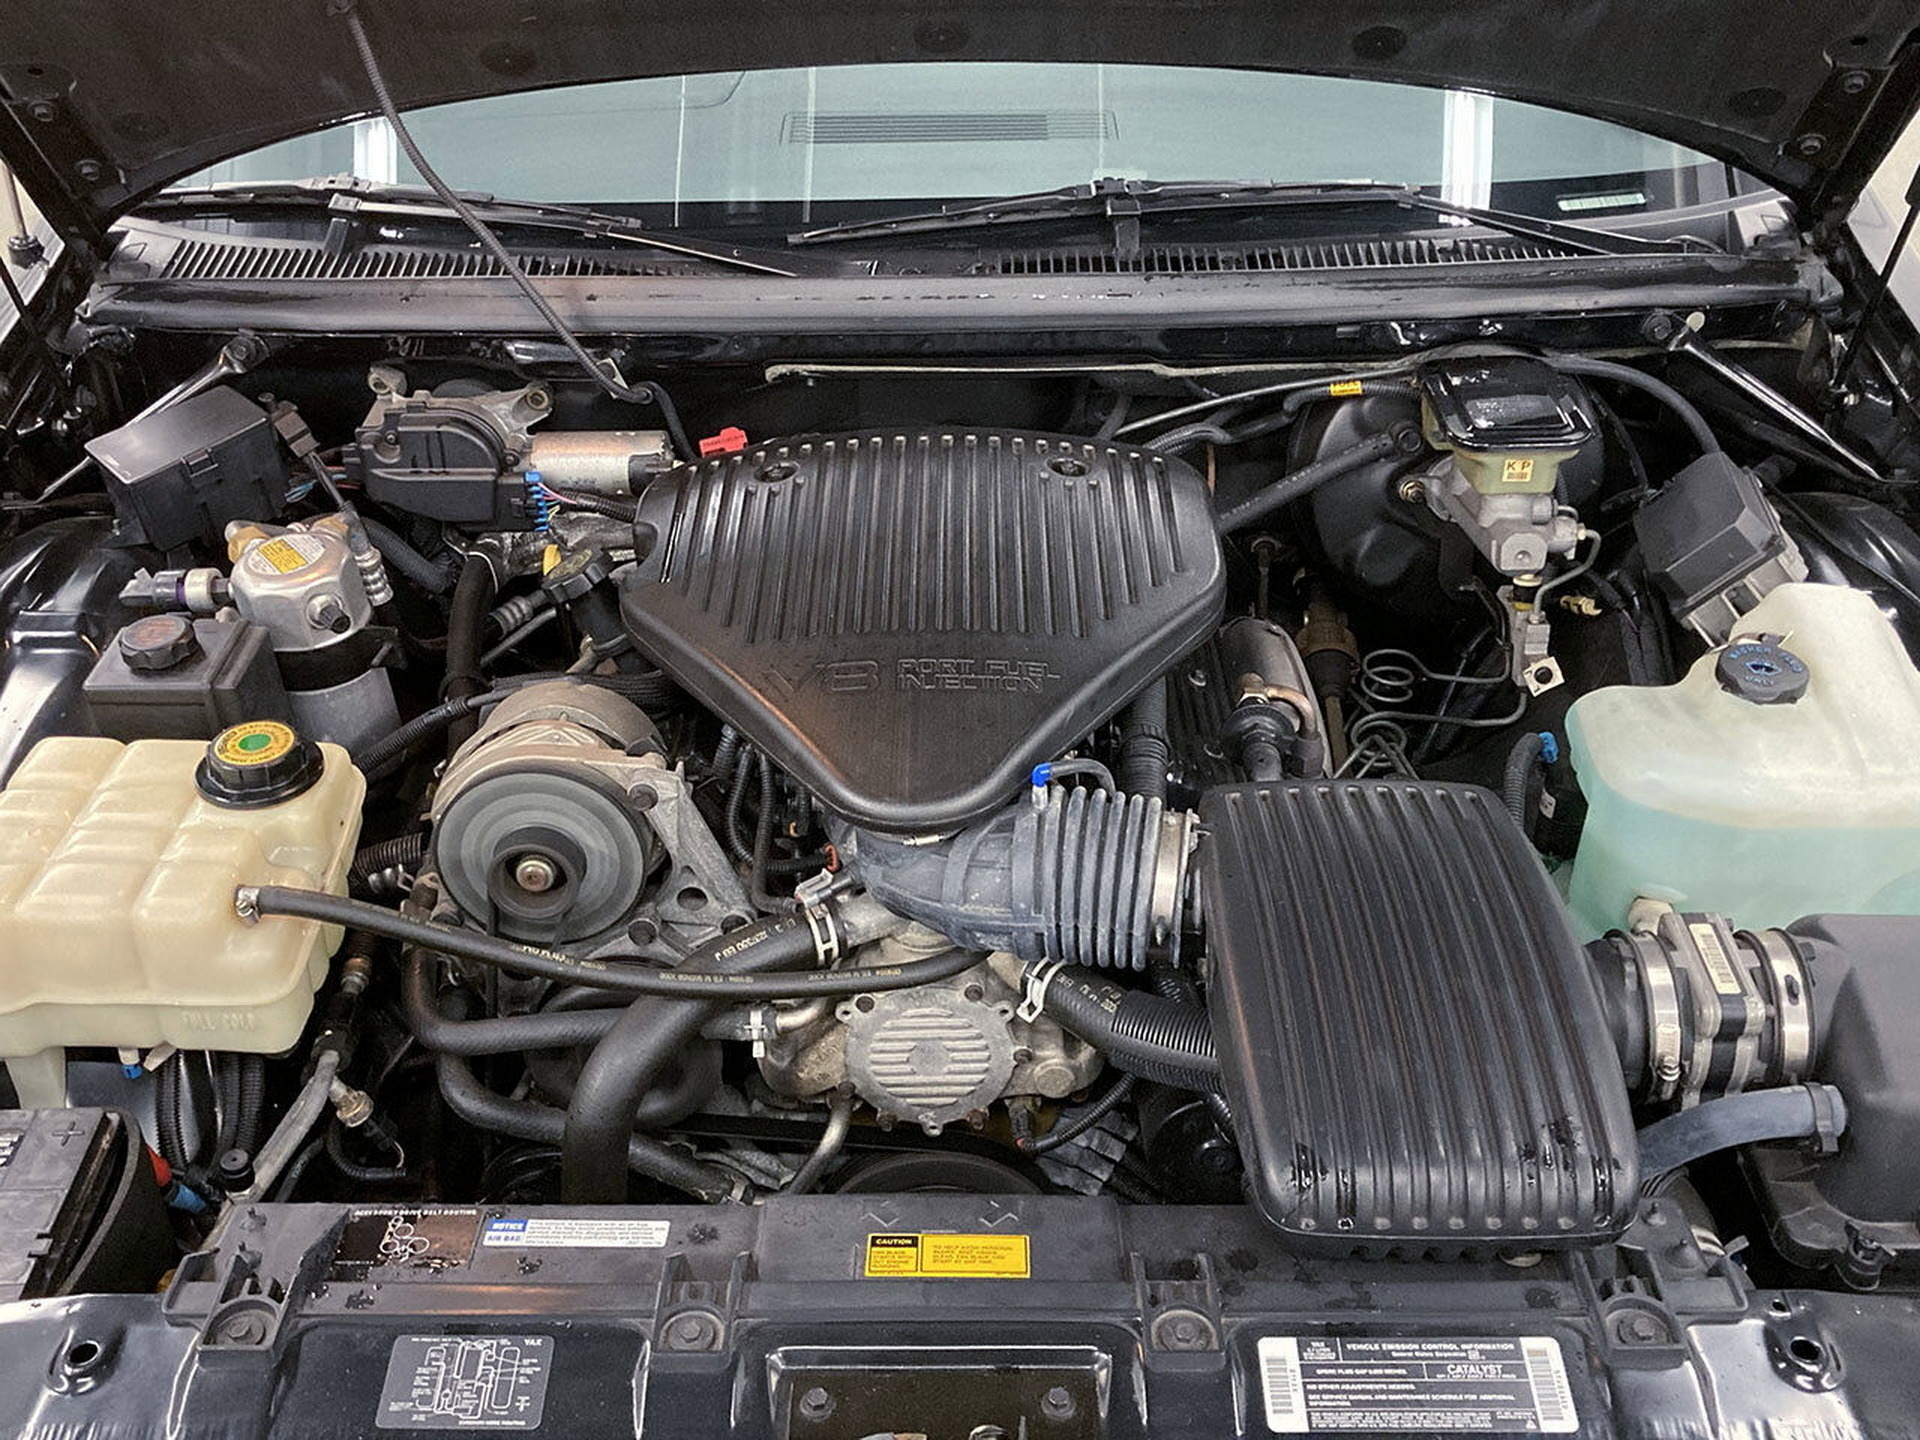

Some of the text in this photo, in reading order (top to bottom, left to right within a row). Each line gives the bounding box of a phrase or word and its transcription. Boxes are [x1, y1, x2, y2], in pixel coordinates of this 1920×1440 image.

[1521, 460, 1532, 471] P
[898, 659, 1061, 678] PORT FUEL
[762, 660, 879, 692] V8
[897, 674, 1043, 692] INJECTION
[875, 1238, 913, 1246] CAUTION
[1346, 1343, 1515, 1351] VEHICLE EMISSION CONTROL INFORMATION
[1446, 1364, 1503, 1375] CATALYST
